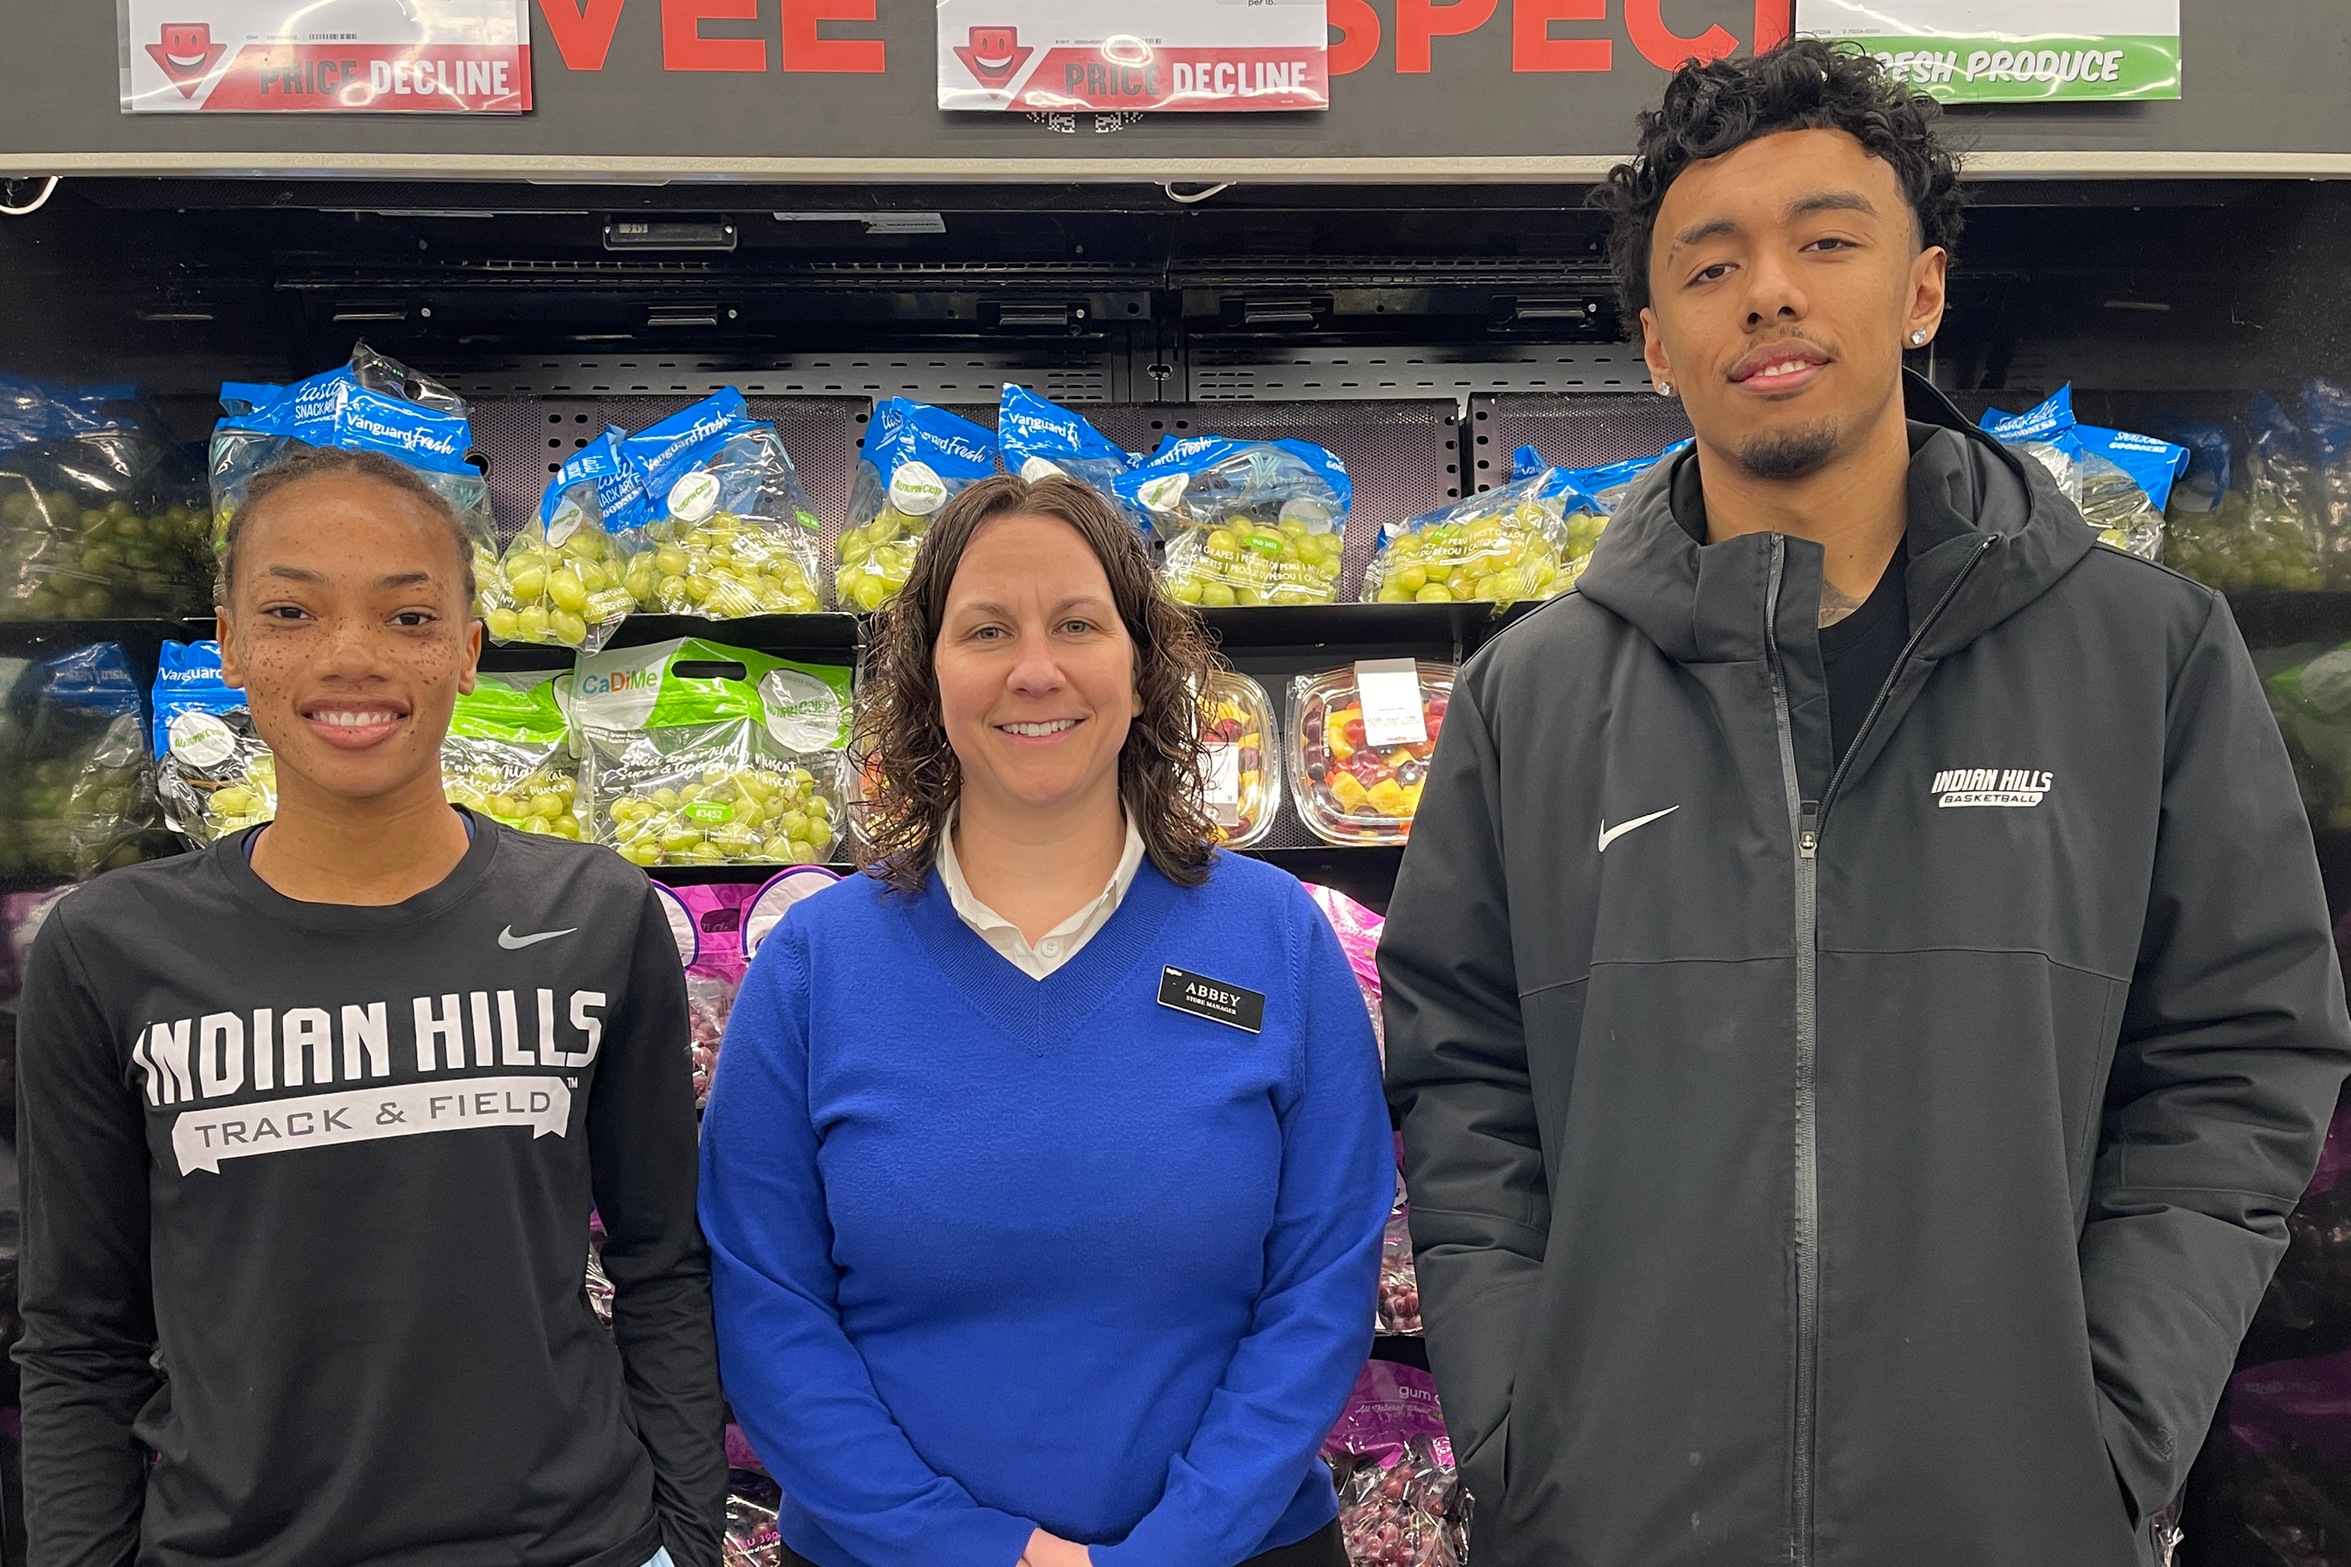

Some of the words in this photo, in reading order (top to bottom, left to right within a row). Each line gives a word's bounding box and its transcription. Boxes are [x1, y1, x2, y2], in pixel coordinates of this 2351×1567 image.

[260, 59, 357, 95] PRICE
[370, 60, 510, 96] DECLINE
[1065, 63, 1161, 96] PRICE
[1172, 61, 1307, 96] DECLINE
[1965, 50, 2124, 82] PRODUCE
[582, 667, 658, 695] CaDiMe
[1930, 768, 1999, 794] INDIAN
[1999, 768, 2054, 793] HILLS
[1944, 794, 2037, 804] BASKETBALL
[1185, 982, 1241, 1007] ABBEY
[1185, 994, 1206, 1007] STORE
[1206, 1001, 1237, 1016] MANAGER
[132, 1001, 391, 1107] INDIAN
[412, 988, 607, 1072] HILLS
[194, 1106, 354, 1149] TRACK
[375, 1101, 407, 1126] &
[429, 1090, 552, 1120] FIELD
[1399, 1386, 1431, 1401] gum
[759, 1531, 781, 1544] 390
